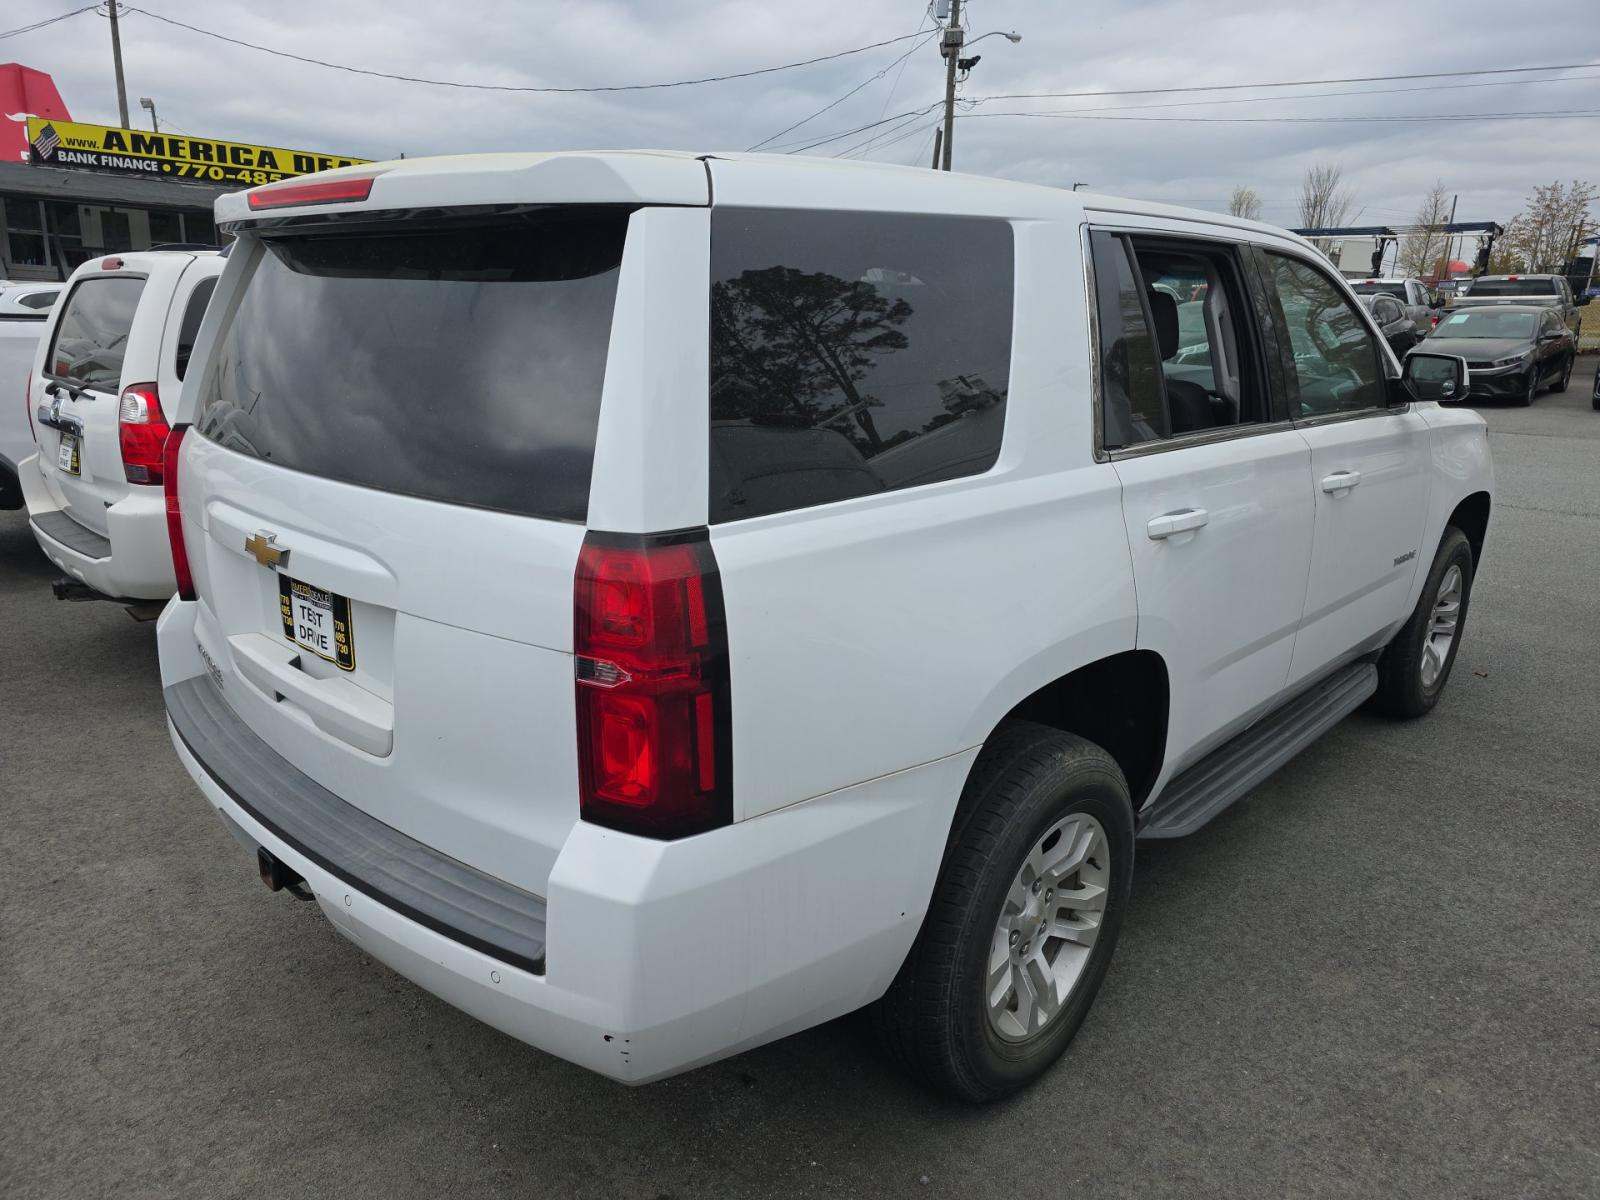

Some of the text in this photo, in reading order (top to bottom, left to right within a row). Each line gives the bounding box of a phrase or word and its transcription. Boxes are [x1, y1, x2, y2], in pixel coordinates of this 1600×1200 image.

[57, 150, 98, 166] BANK
[101, 155, 159, 172] FINANCE
[103, 130, 281, 170] AMERICA
[299, 604, 323, 628] TEST
[299, 624, 328, 650] DRIVE
